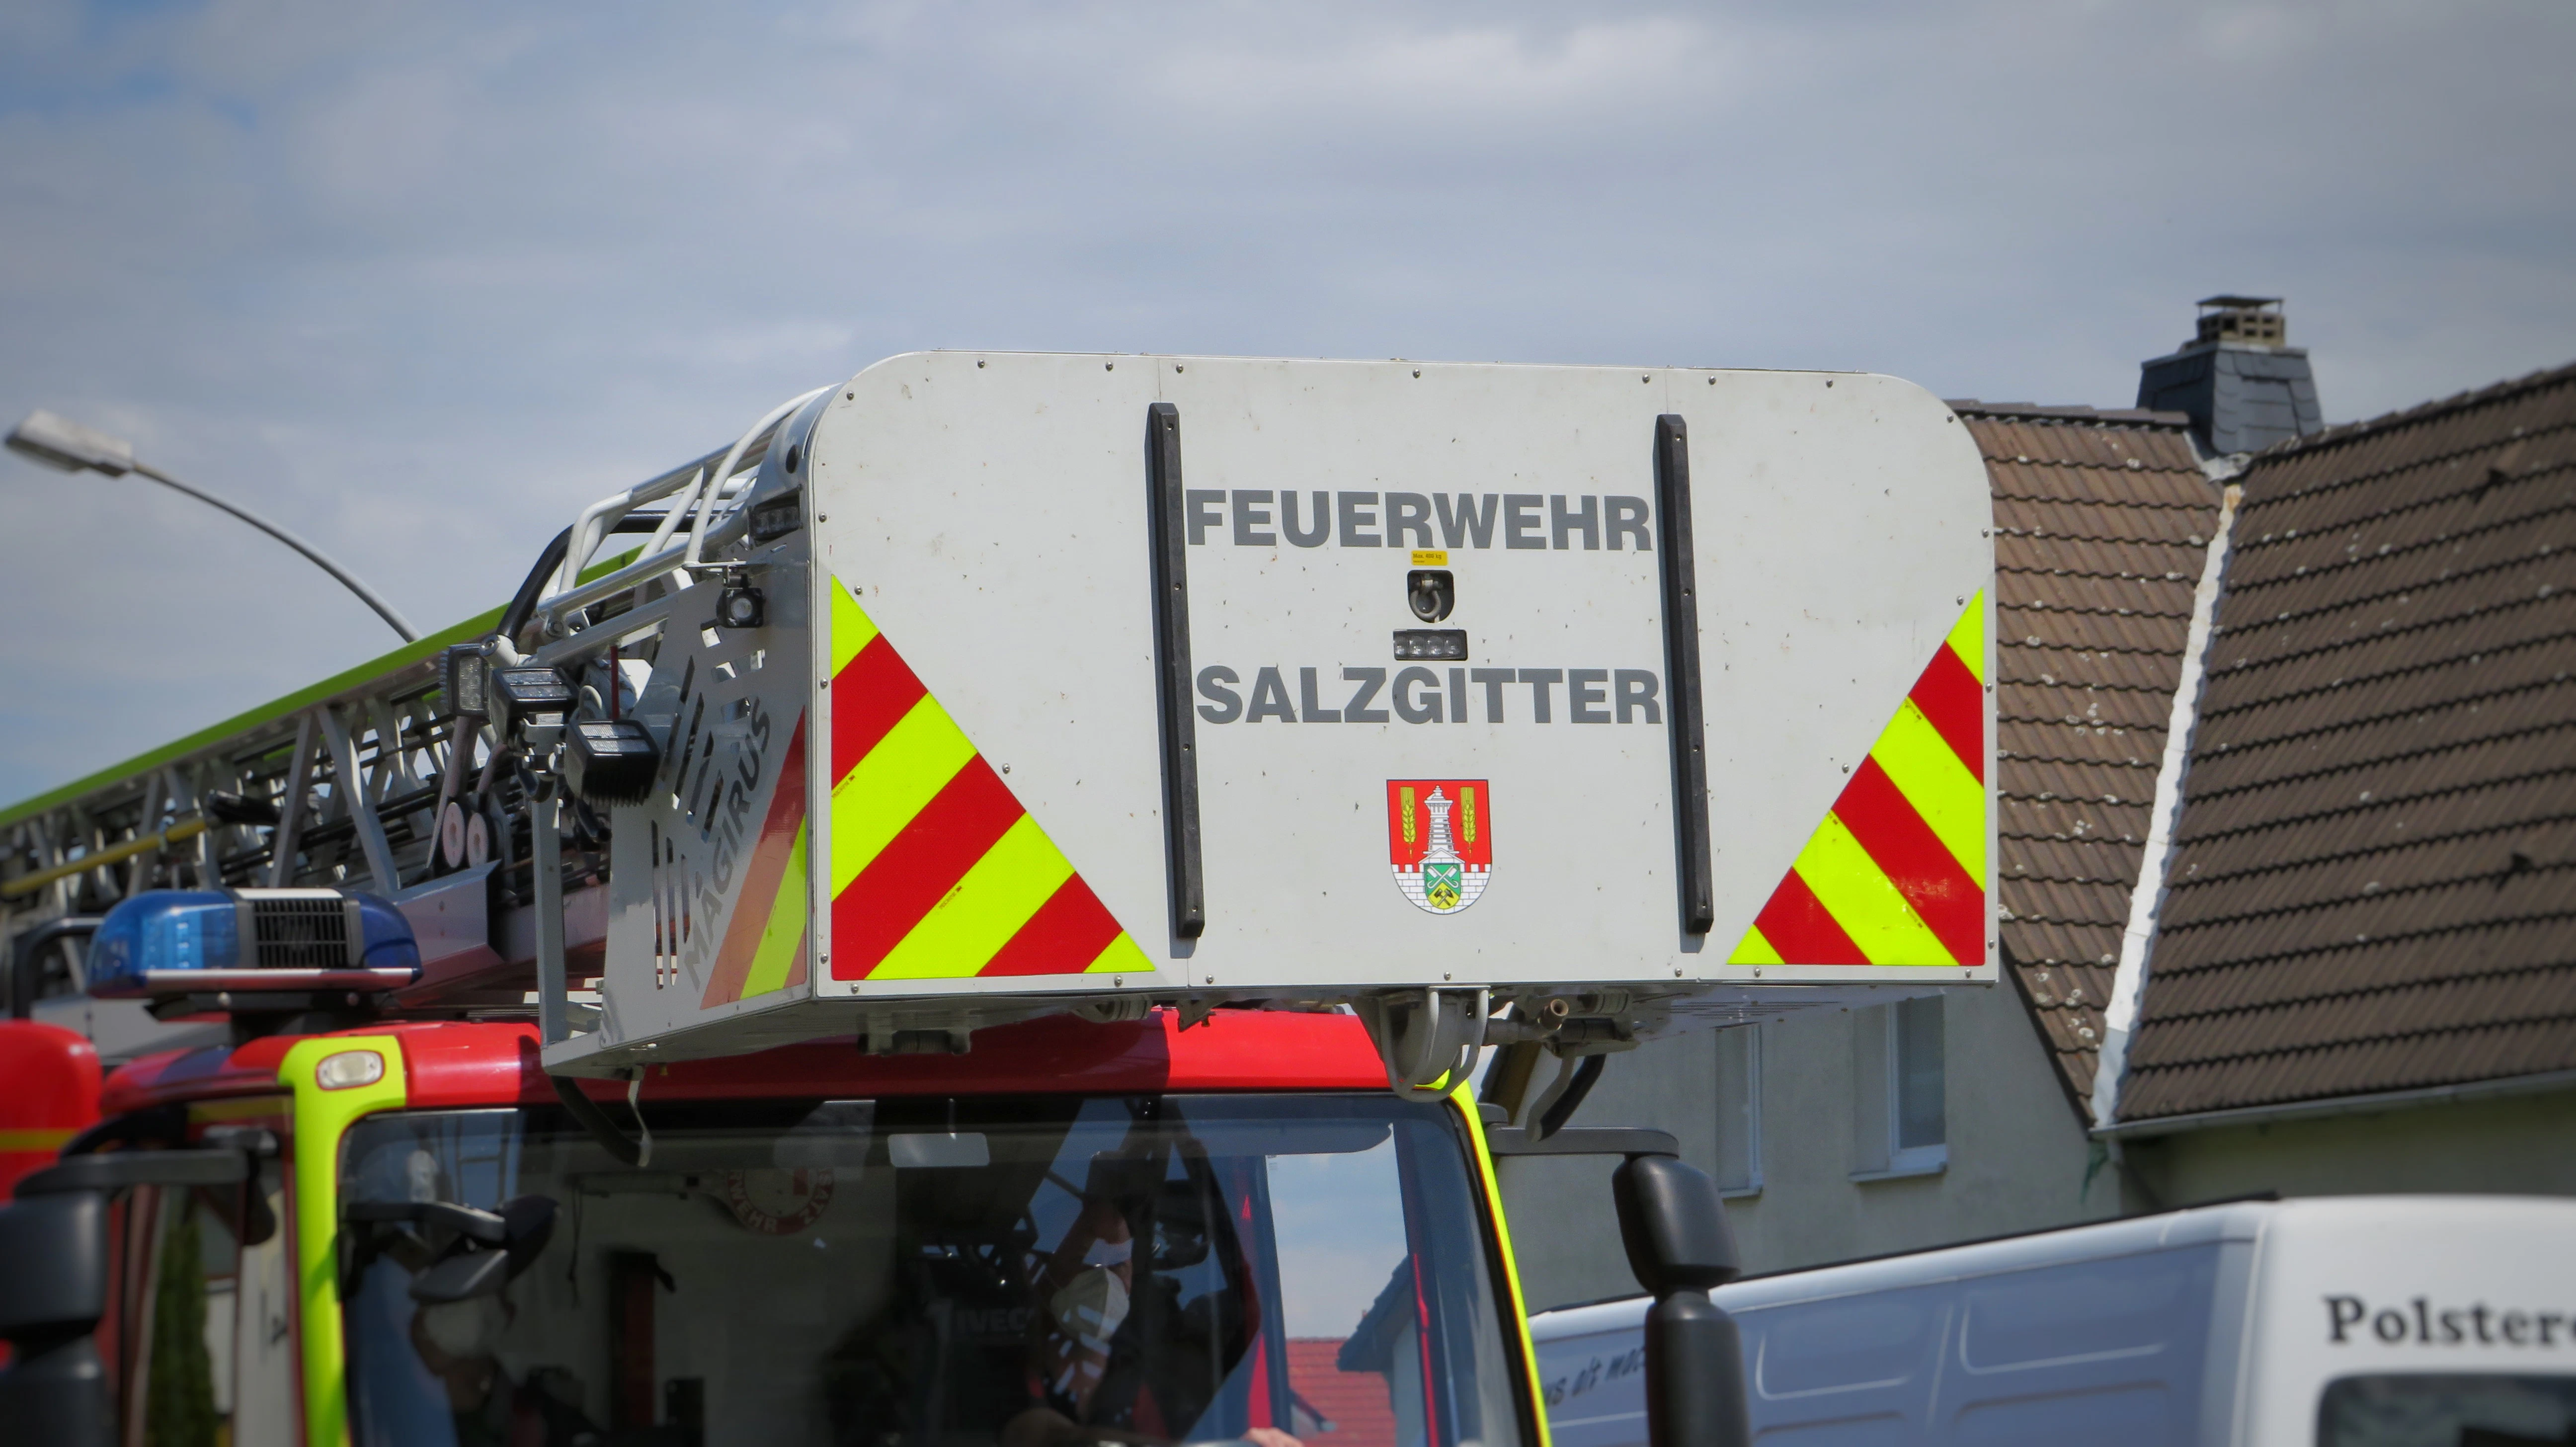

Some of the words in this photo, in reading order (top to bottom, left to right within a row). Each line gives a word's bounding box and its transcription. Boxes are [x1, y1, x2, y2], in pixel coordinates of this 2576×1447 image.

[1186, 489, 1653, 551] FEUERWEHR
[1197, 665, 1663, 724] SALZGITTER
[684, 697, 770, 993] MAGIRUS
[2324, 1294, 2576, 1345] Polster
